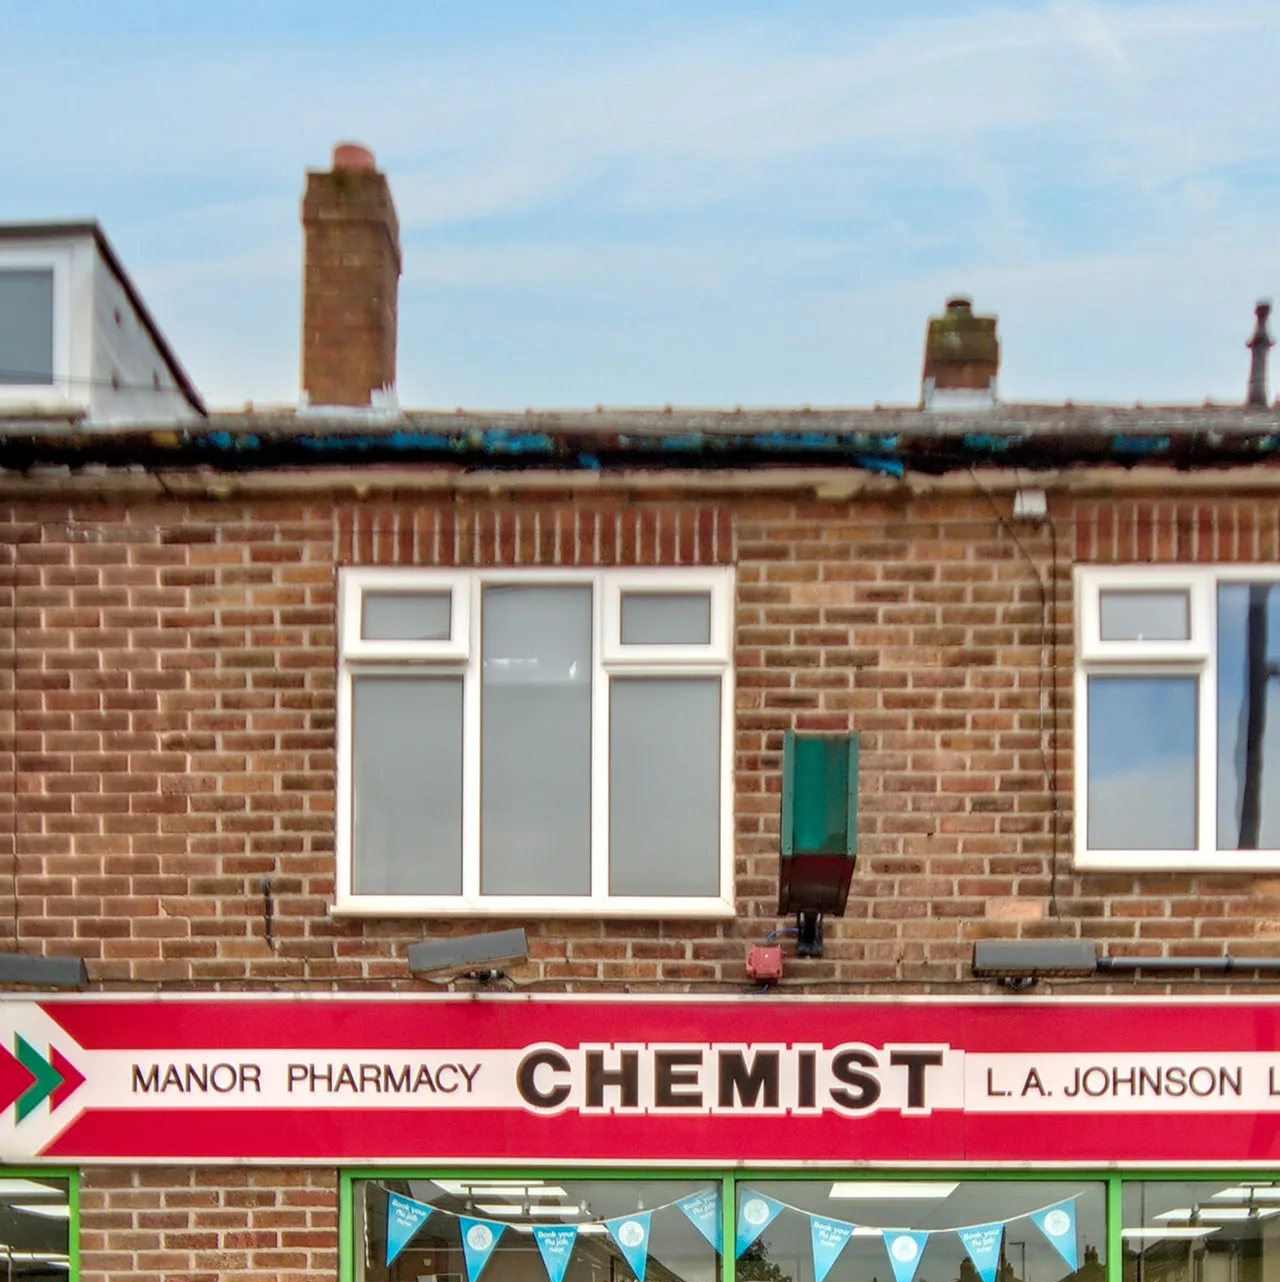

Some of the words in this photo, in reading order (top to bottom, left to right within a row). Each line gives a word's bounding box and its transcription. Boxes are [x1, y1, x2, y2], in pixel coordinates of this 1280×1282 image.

[131, 1063, 262, 1093] MANOR
[287, 1063, 482, 1093] PHARMACY
[515, 1047, 945, 1111] CHEMIST
[1064, 1065, 1243, 1098] JOHNSON
